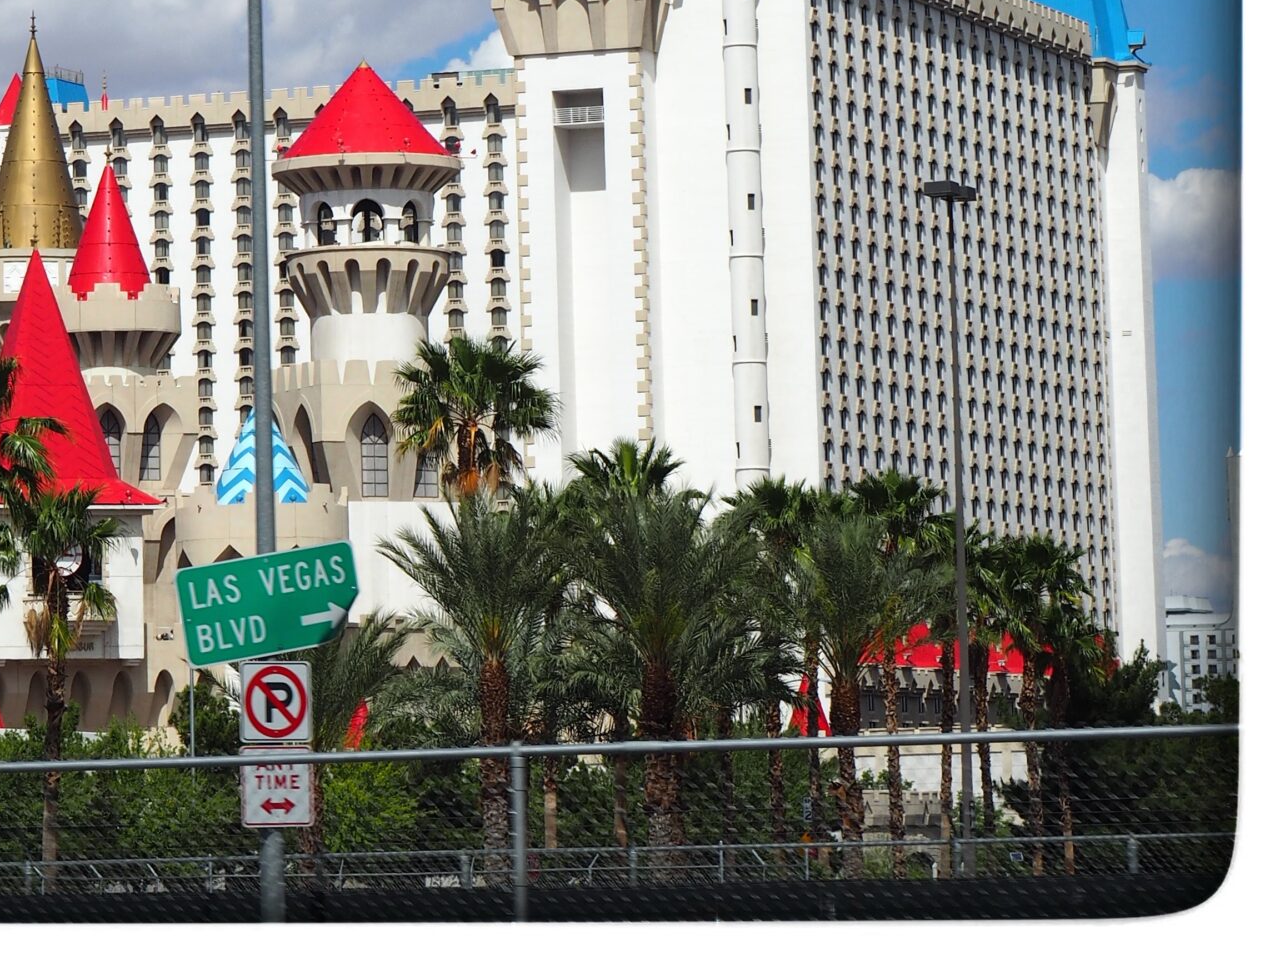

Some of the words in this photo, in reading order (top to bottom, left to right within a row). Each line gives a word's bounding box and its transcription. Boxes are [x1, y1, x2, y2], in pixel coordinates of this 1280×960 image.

[188, 574, 241, 610] LAS
[258, 555, 346, 596] VEGAS
[197, 615, 266, 653] BLVD
[255, 774, 300, 790] TIME
